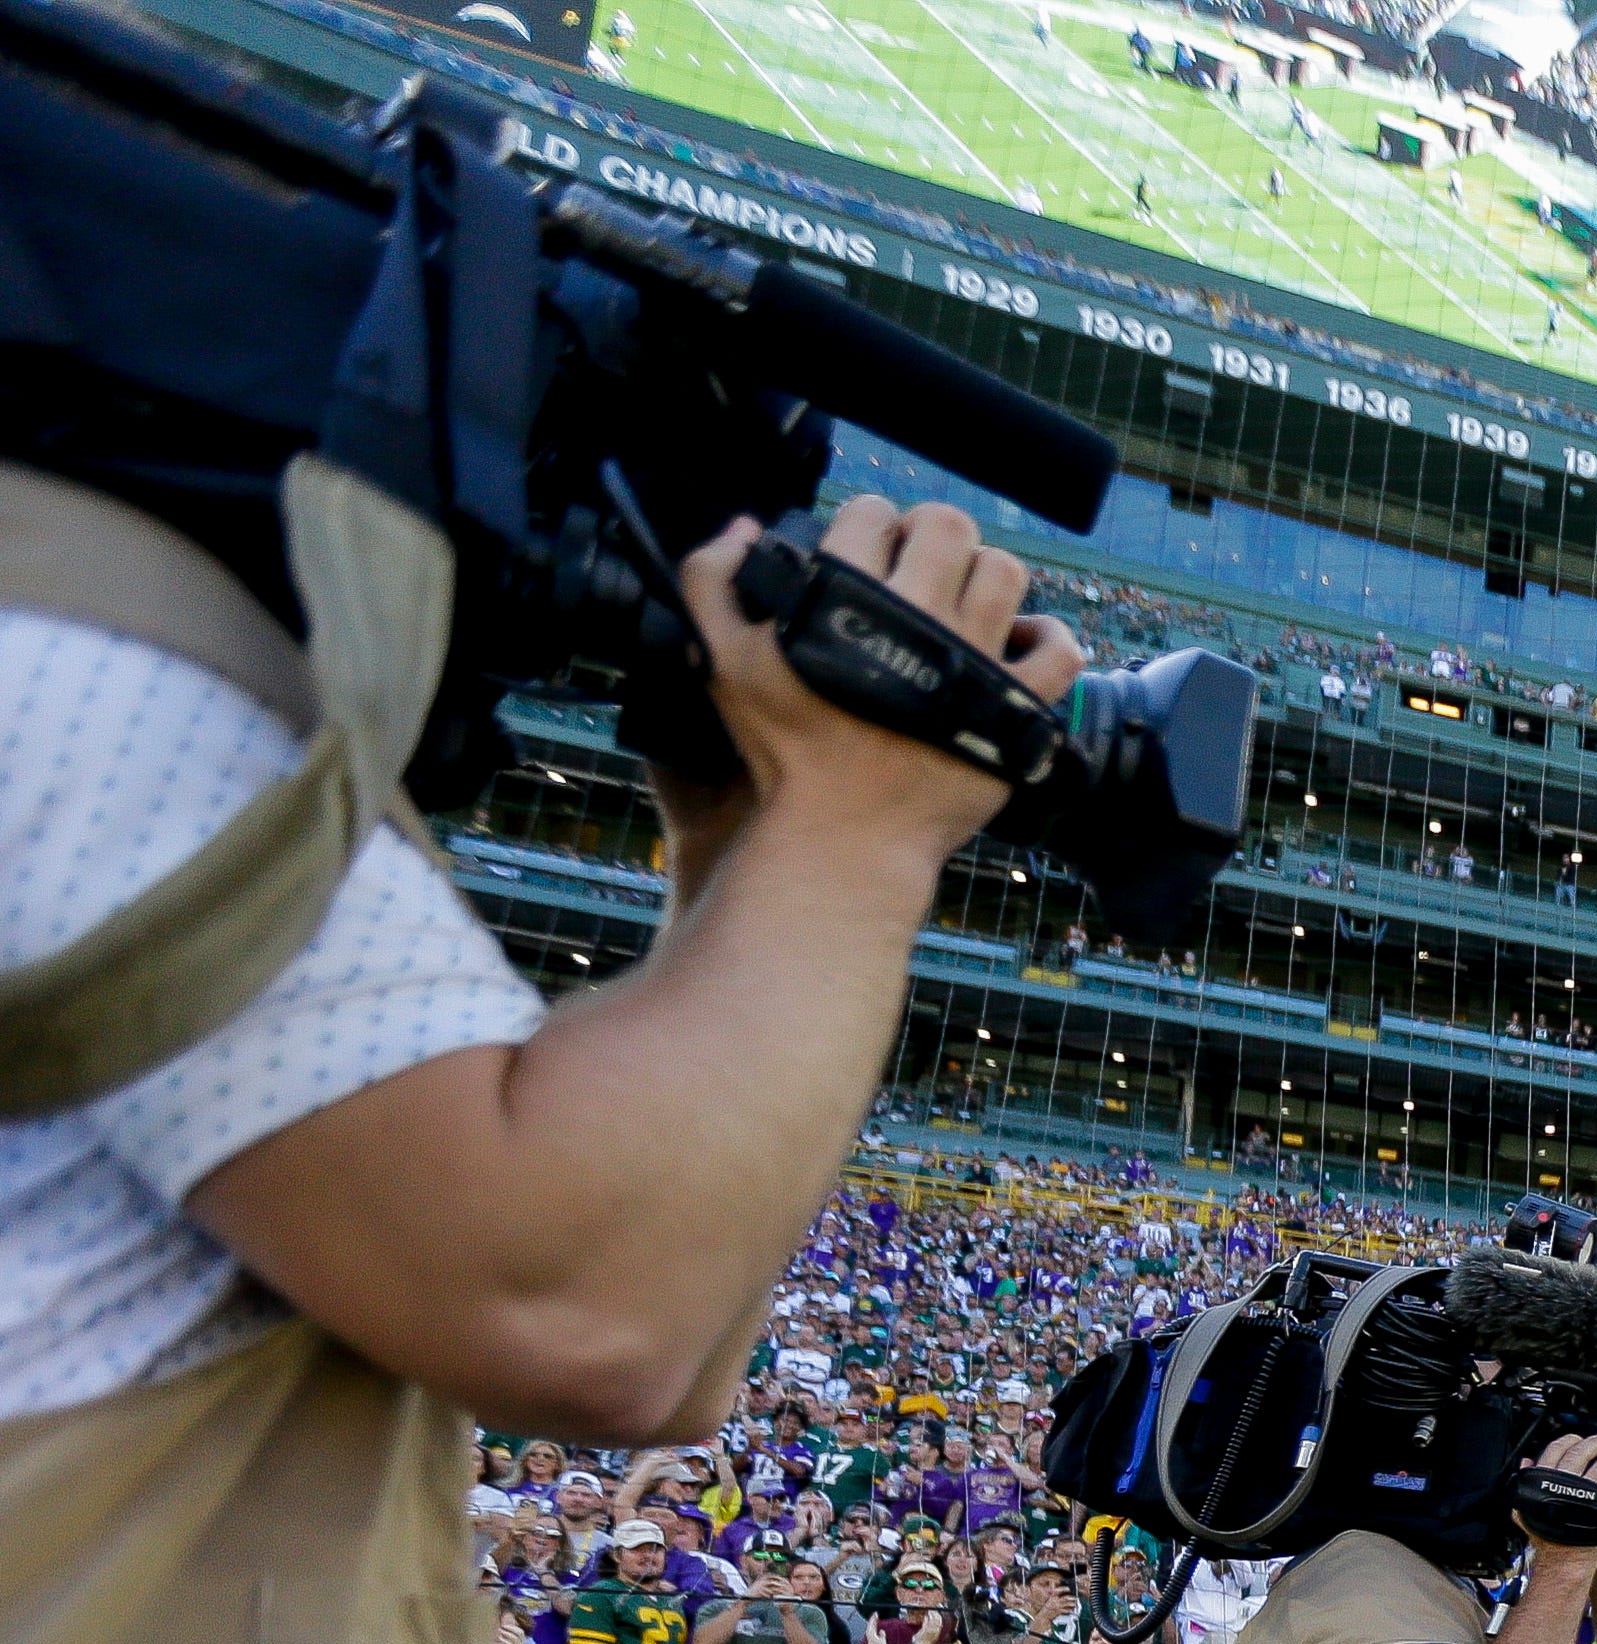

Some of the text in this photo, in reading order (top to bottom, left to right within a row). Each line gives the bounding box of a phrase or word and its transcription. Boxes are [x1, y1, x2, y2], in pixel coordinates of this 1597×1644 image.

[598, 154, 879, 267] CHAMPIONS
[942, 262, 1040, 319] 1929
[1076, 303, 1174, 358] 1930
[1208, 341, 1292, 393] 1931
[1325, 377, 1413, 427] 1936
[1446, 411, 1531, 460] 1939
[811, 1451, 854, 1485] 17
[1541, 1480, 1596, 1500] FUJINON
